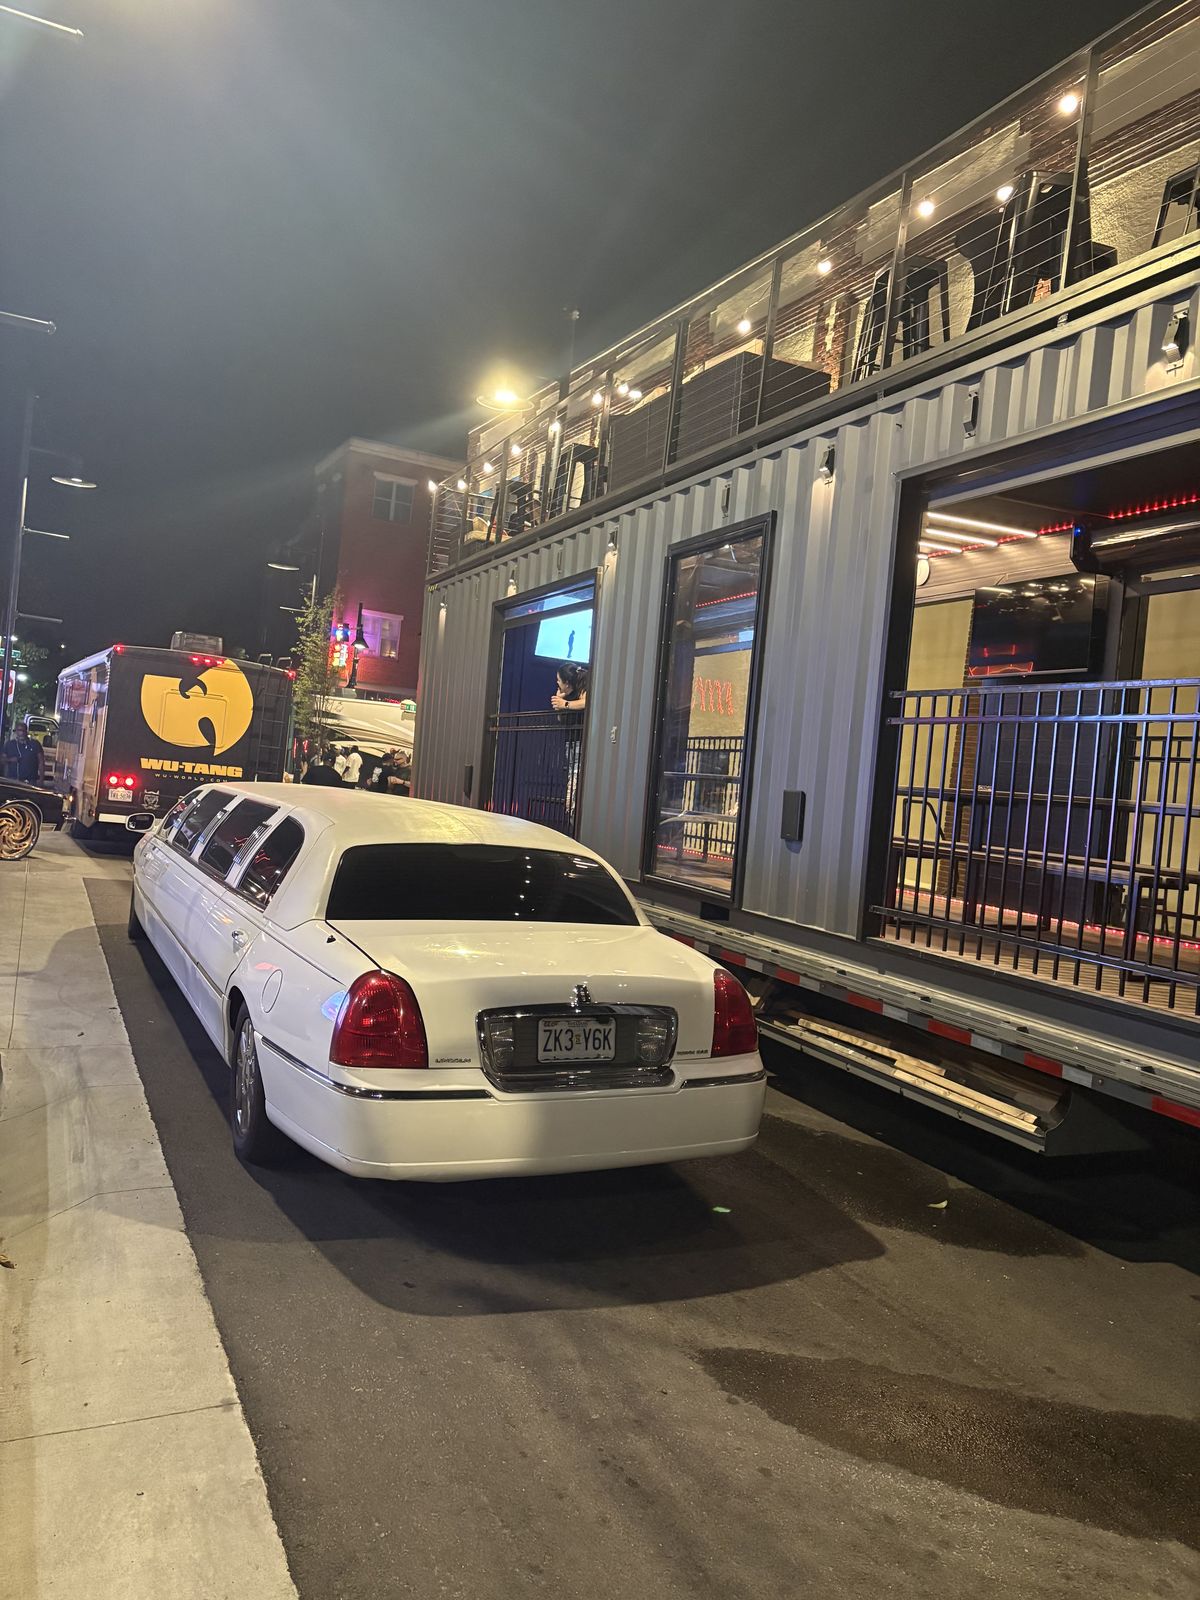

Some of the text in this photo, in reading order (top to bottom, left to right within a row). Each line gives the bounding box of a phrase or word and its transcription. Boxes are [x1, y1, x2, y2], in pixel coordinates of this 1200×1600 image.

[140, 757, 243, 778] WU-TANG
[543, 1028, 574, 1052] ZK3
[583, 1028, 612, 1051] Y6K
